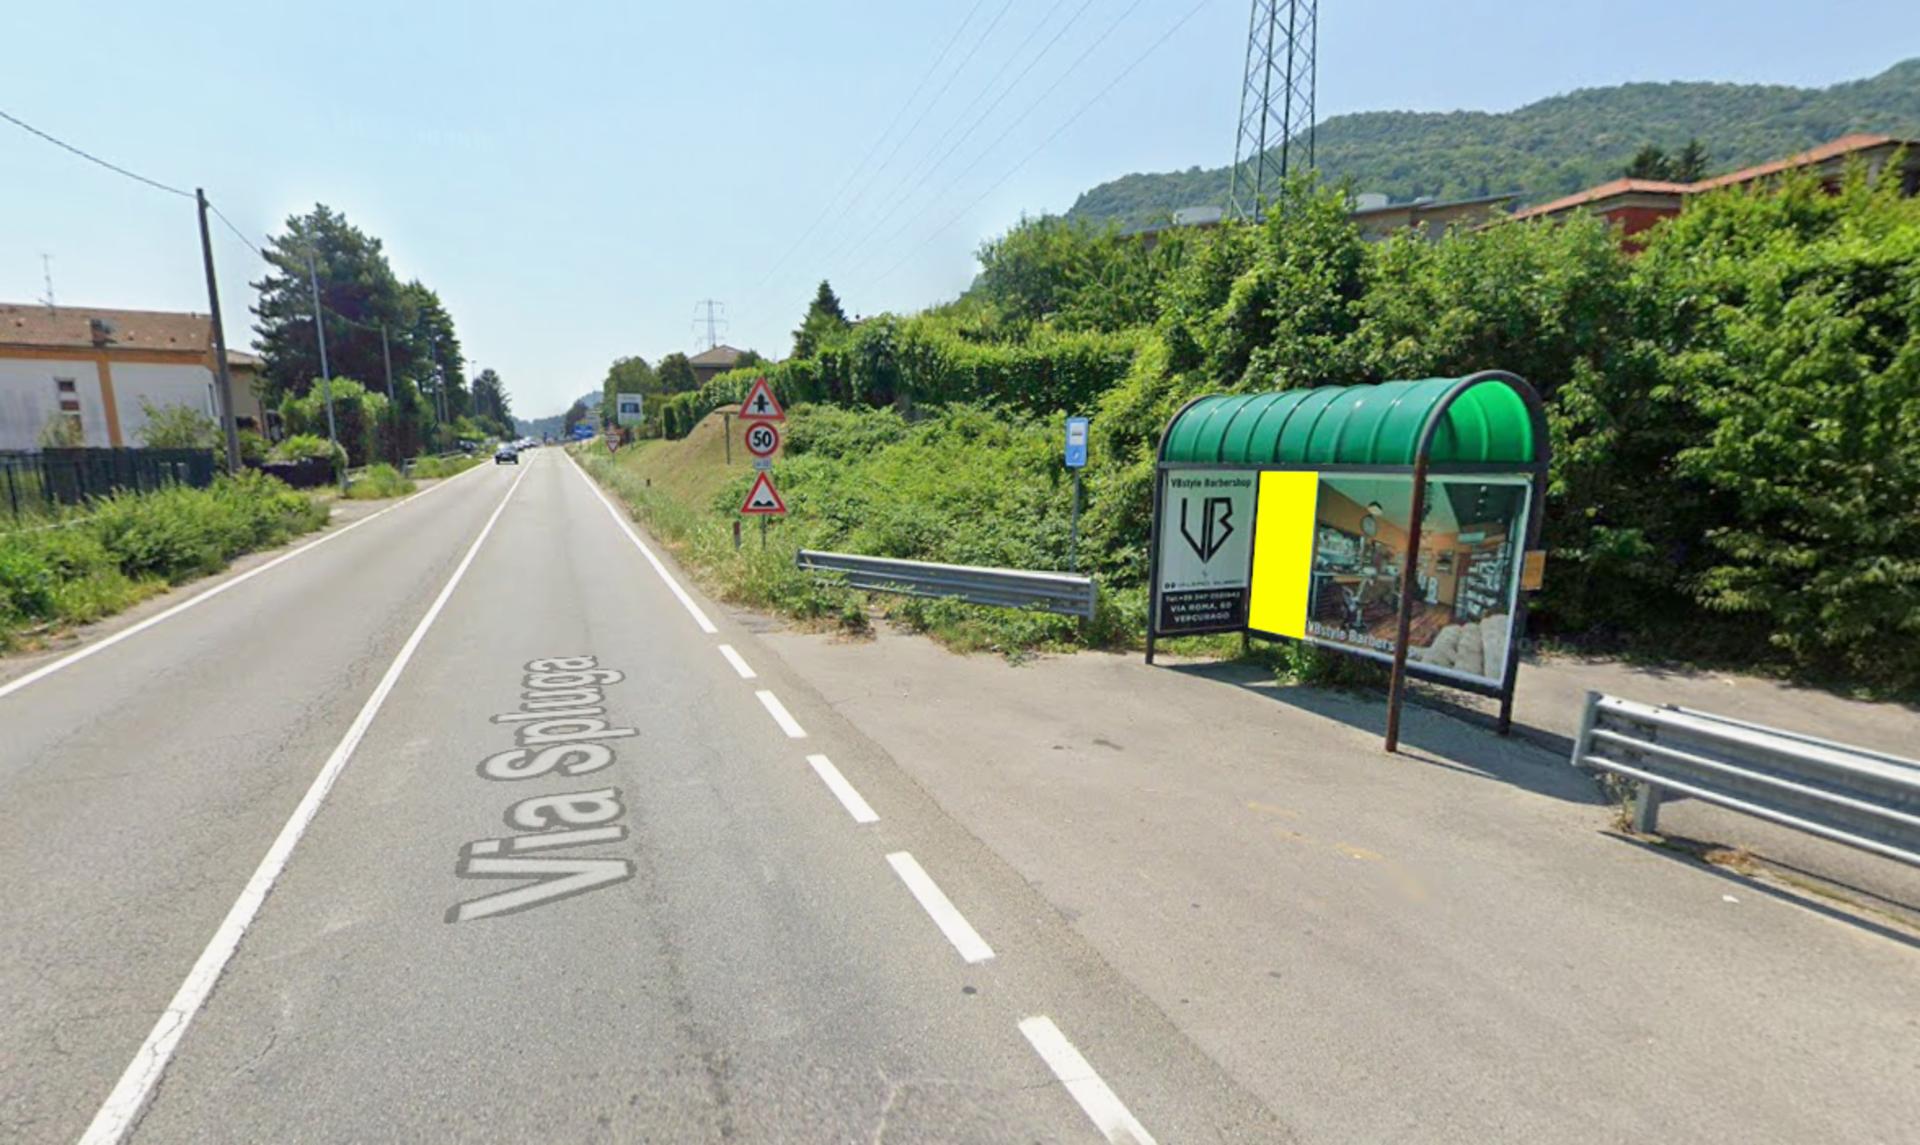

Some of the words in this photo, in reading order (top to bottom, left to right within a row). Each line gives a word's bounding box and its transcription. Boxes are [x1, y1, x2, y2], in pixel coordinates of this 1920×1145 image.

[753, 430, 772, 448] 50
[1171, 477, 1202, 489] VBstyle
[1204, 476, 1252, 488] Barbershop
[1170, 604, 1186, 613] VIA
